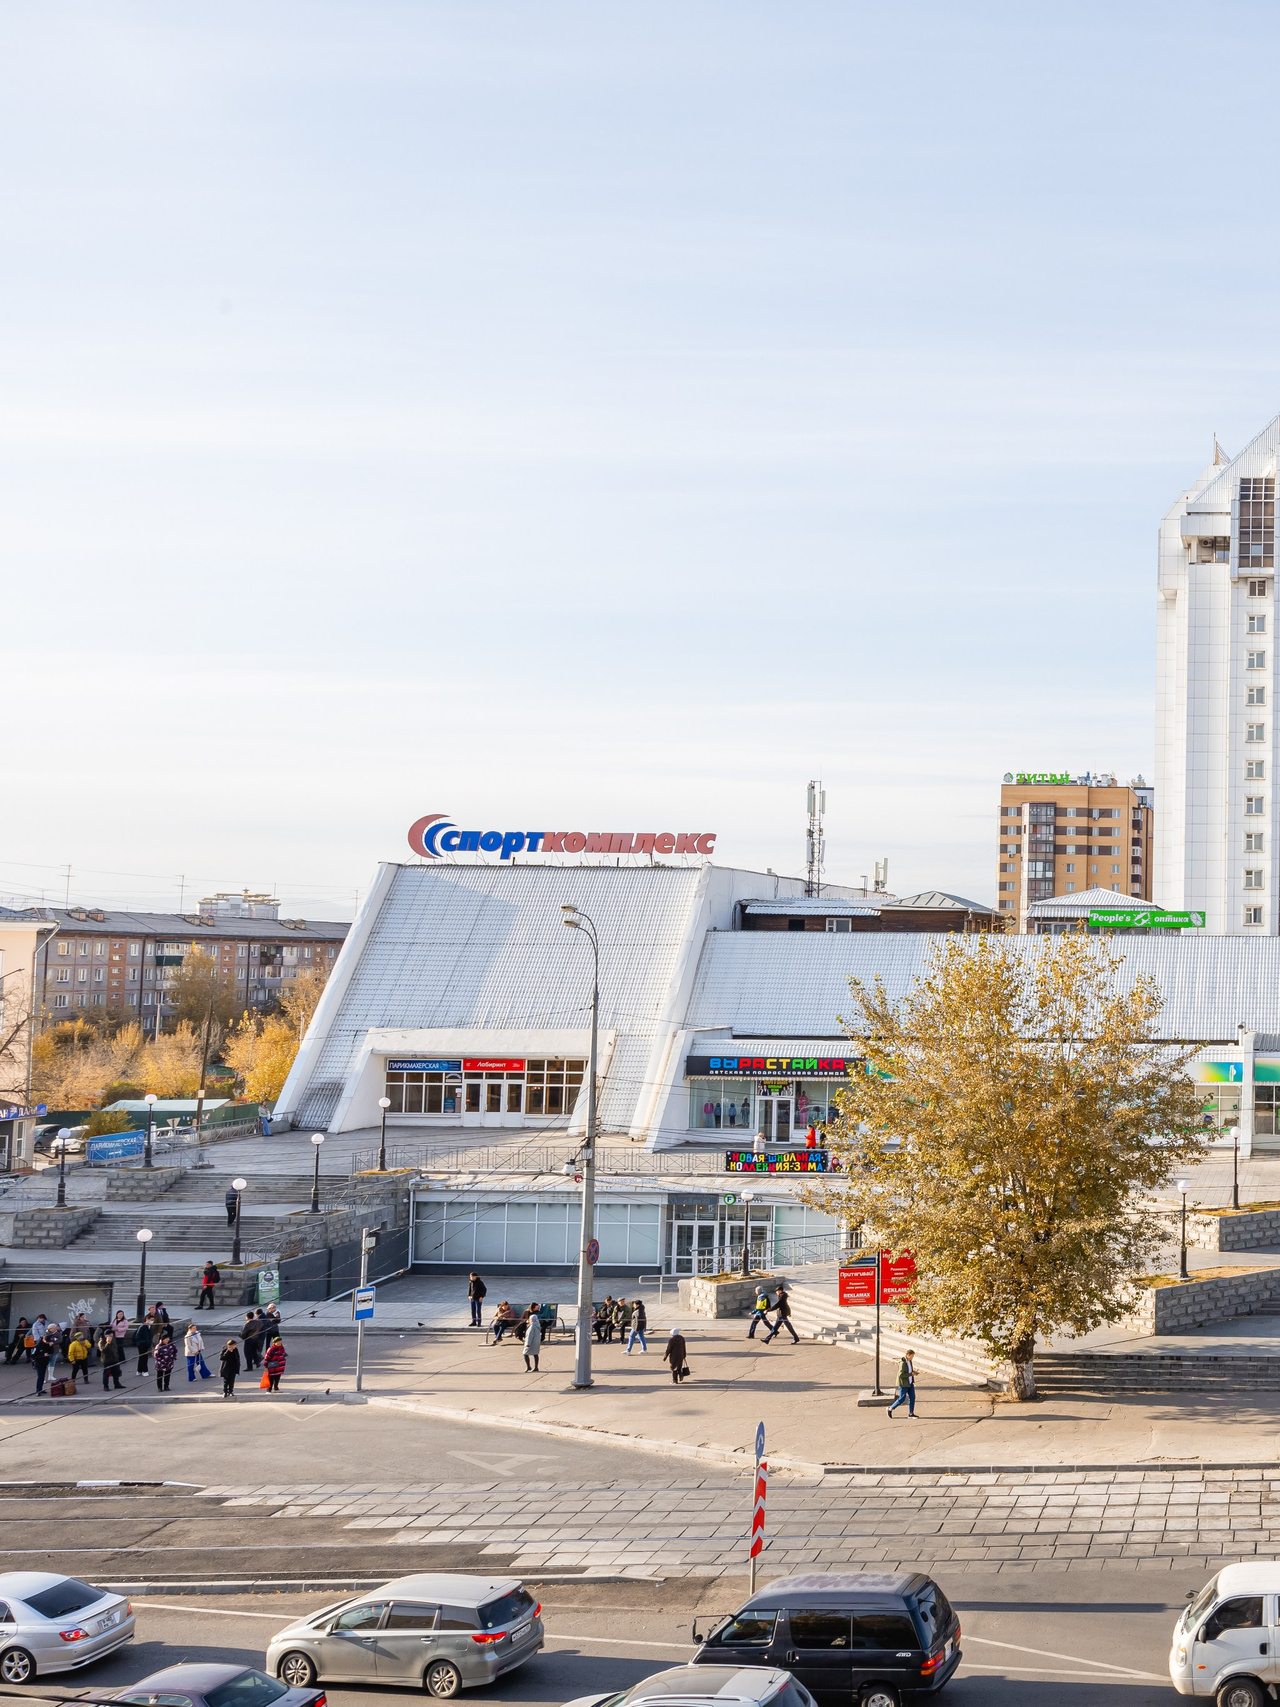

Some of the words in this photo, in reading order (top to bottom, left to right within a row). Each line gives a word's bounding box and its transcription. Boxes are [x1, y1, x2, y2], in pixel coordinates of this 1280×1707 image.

[1016, 773, 1070, 783] ТИТАН
[1090, 913, 1131, 923] People's
[389, 1061, 439, 1069] ПАРИКМАХЕРСКАЯ
[709, 1058, 844, 1070] ВЫРАСТАЙКА
[732, 1153, 764, 1162] НОВАЯ
[768, 1153, 820, 1162] ШКОЛЬНАЯ
